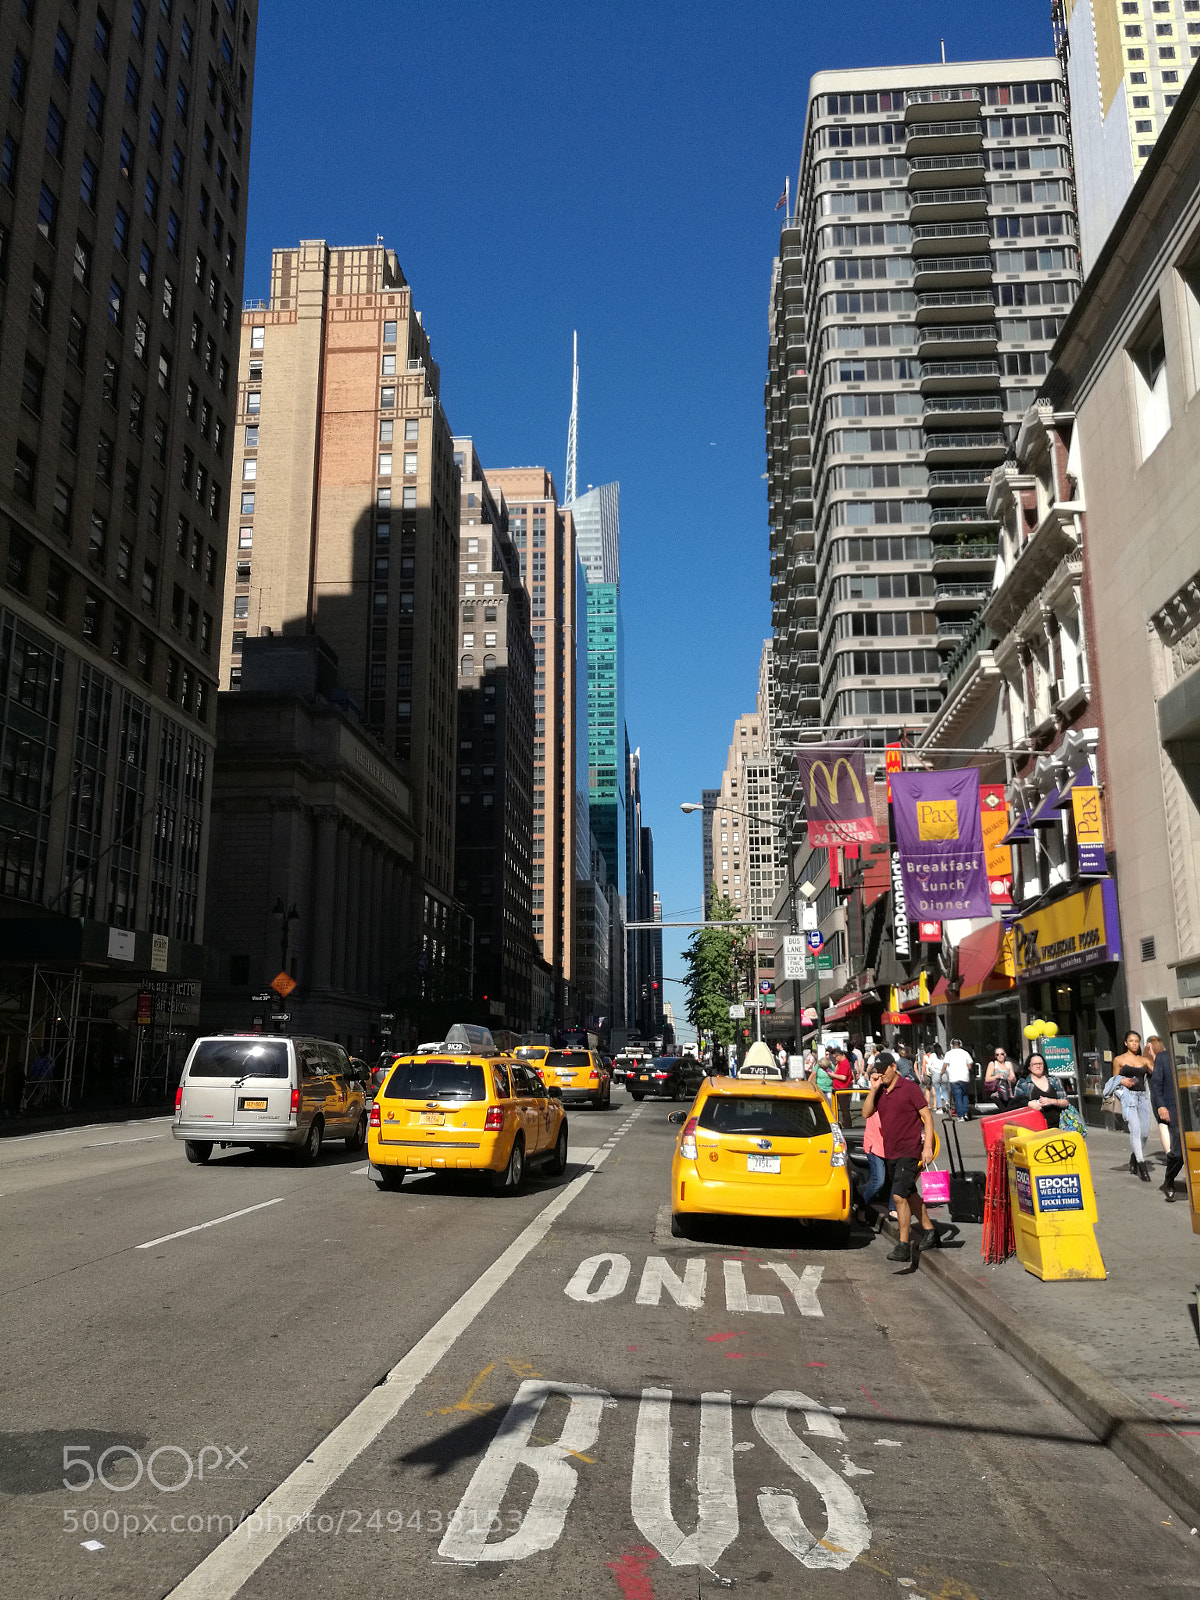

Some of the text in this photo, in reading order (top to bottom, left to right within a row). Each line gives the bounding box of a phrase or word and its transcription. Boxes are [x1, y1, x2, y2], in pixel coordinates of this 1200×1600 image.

[919, 805, 955, 824] Pax
[1077, 795, 1100, 837] Pax
[825, 821, 857, 832] OPEN
[815, 831, 874, 844] 24 HOURS
[906, 859, 979, 873] Breakfast
[922, 880, 965, 891] Lunch
[919, 899, 971, 911] Dinner
[1039, 1177, 1078, 1189] EPOCH
[1040, 1187, 1079, 1195] WEEKEND
[564, 1252, 826, 1318] ONLY
[436, 1379, 873, 1570] BUS
